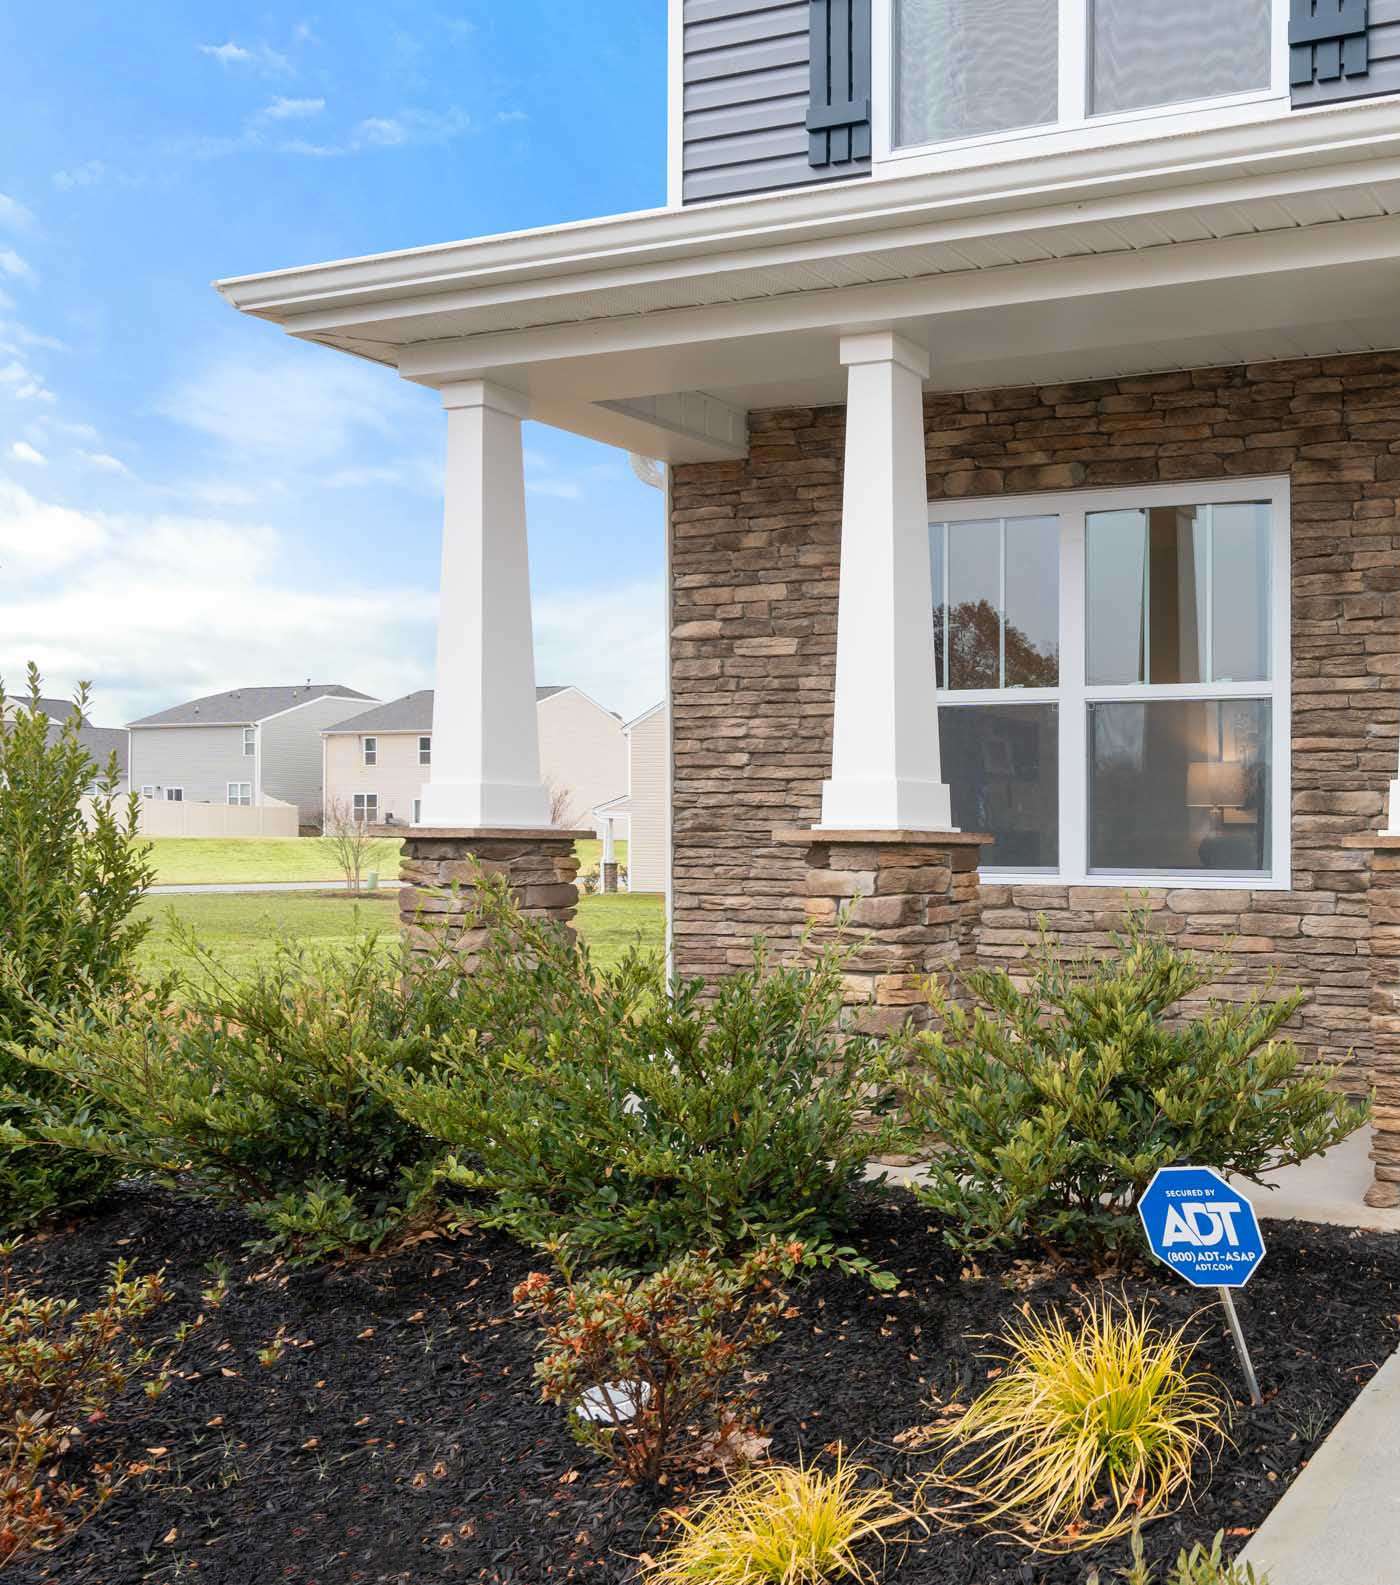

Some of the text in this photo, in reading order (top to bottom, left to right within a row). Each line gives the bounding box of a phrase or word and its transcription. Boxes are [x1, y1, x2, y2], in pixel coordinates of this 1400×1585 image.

[1165, 1188, 1215, 1198] SECURED BY
[1161, 1201, 1241, 1247] ADT
[1167, 1251, 1256, 1264] (800) ADT-ASAP
[1195, 1263, 1234, 1271] ADT.COM
